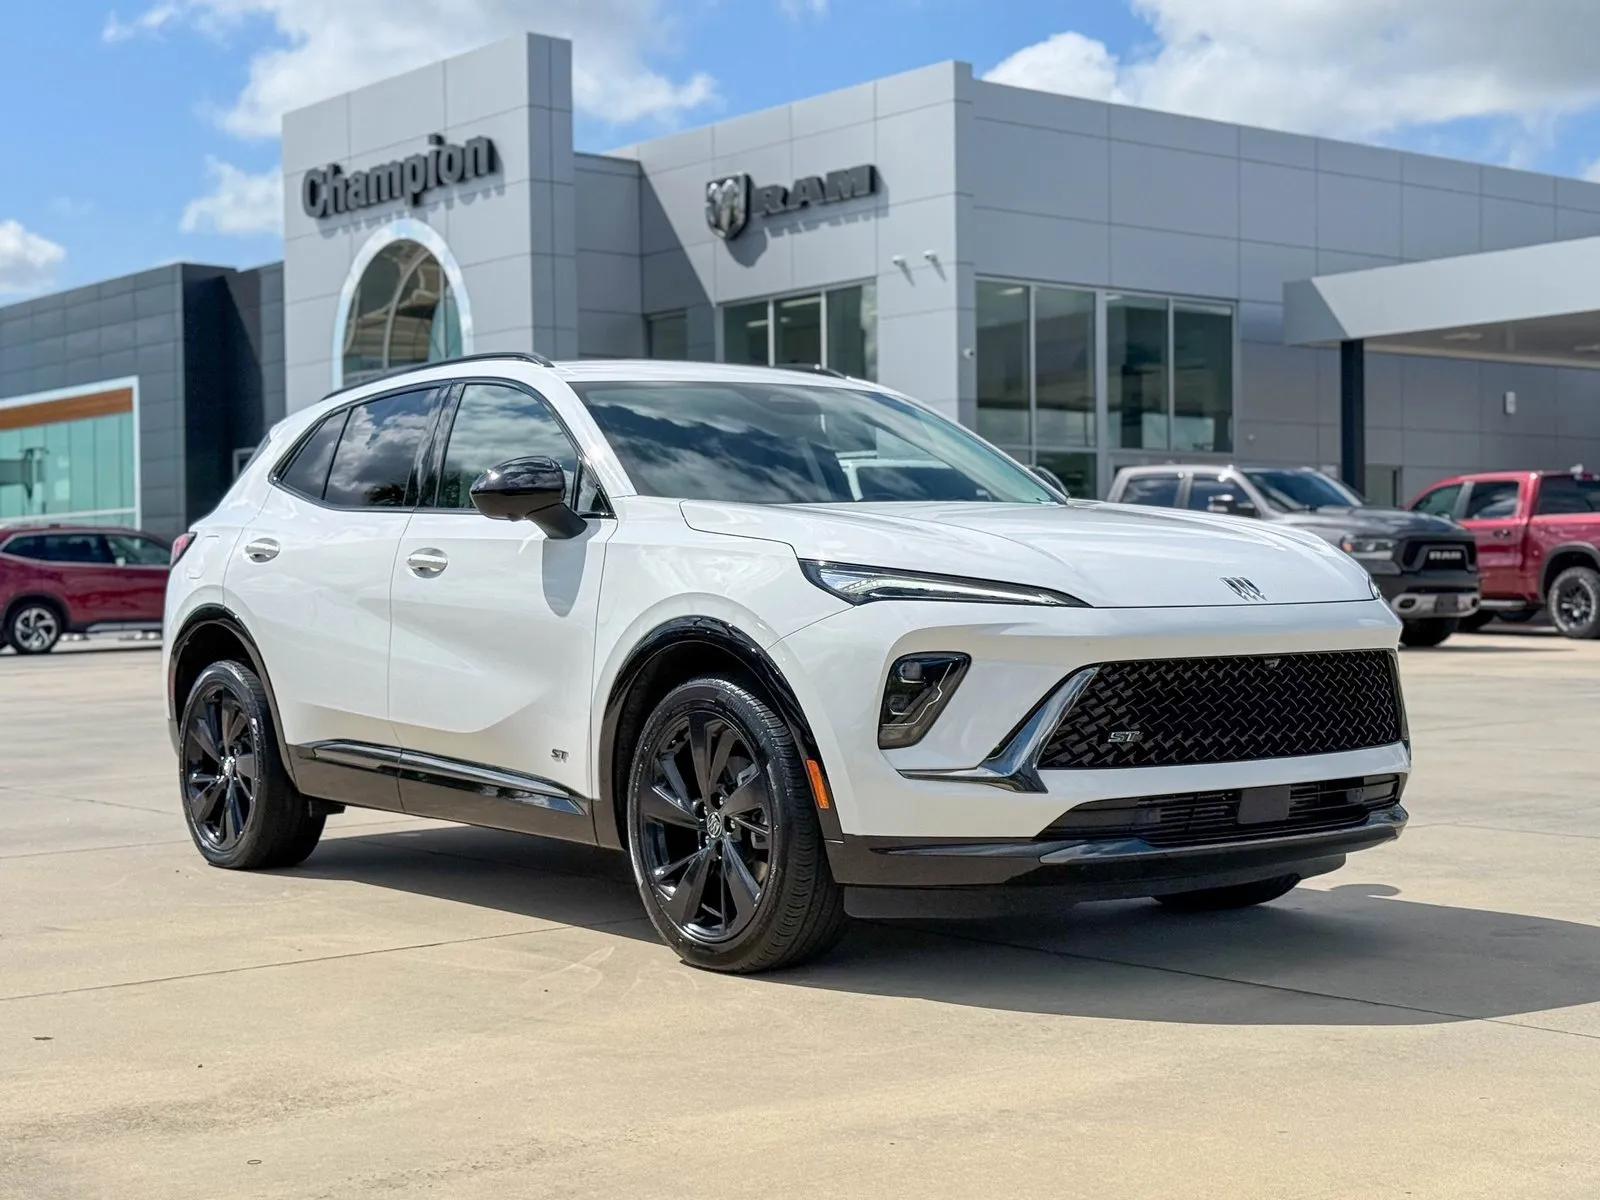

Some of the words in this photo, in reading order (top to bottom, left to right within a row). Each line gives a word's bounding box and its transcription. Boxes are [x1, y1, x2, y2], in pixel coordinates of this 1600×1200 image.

[302, 133, 496, 218] Champion
[751, 164, 876, 217] RAM
[1108, 731, 1141, 743] ST
[550, 748, 569, 760] ST
